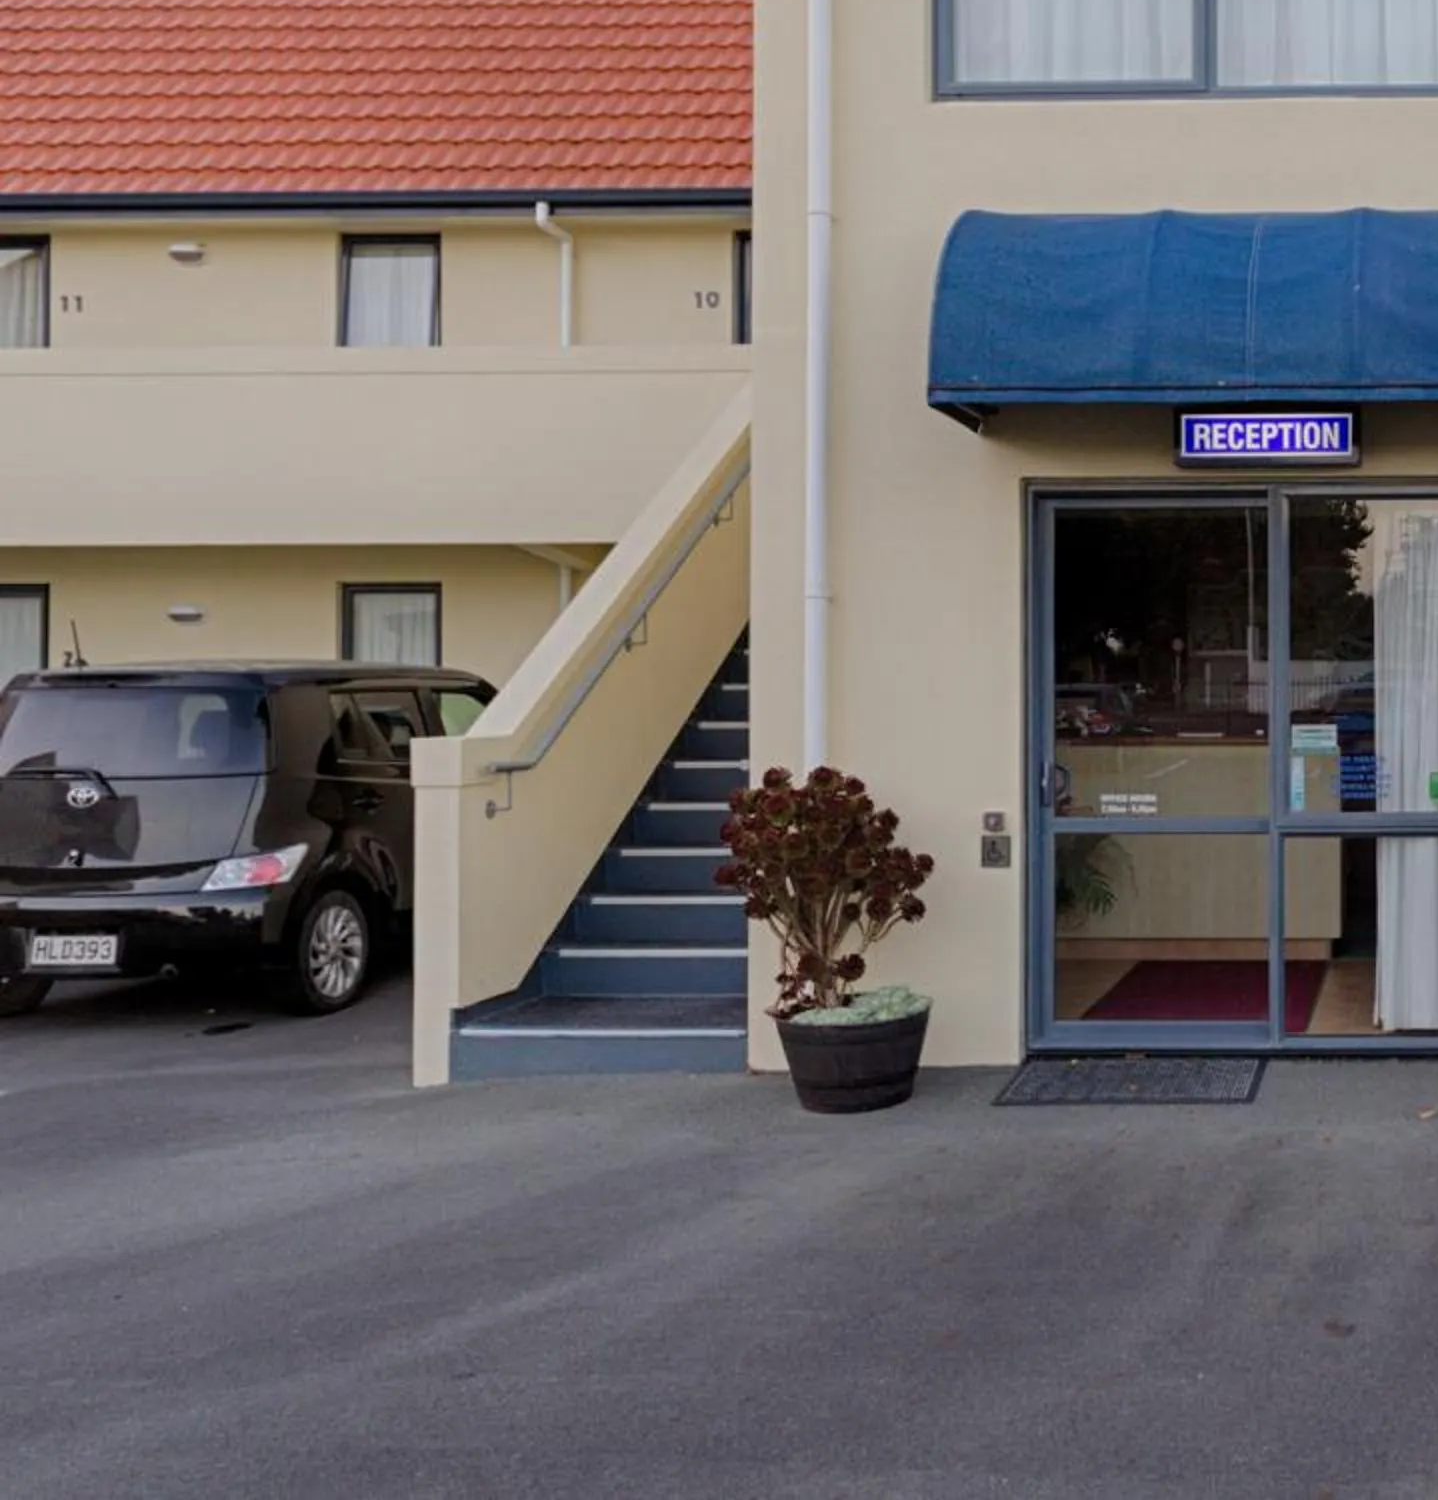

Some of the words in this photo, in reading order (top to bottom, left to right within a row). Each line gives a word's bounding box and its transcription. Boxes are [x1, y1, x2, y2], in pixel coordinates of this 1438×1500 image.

[60, 295, 82, 313] 11
[694, 291, 720, 309] 10
[1193, 422, 1340, 451] RECEPTION
[35, 940, 112, 960] HLD393
